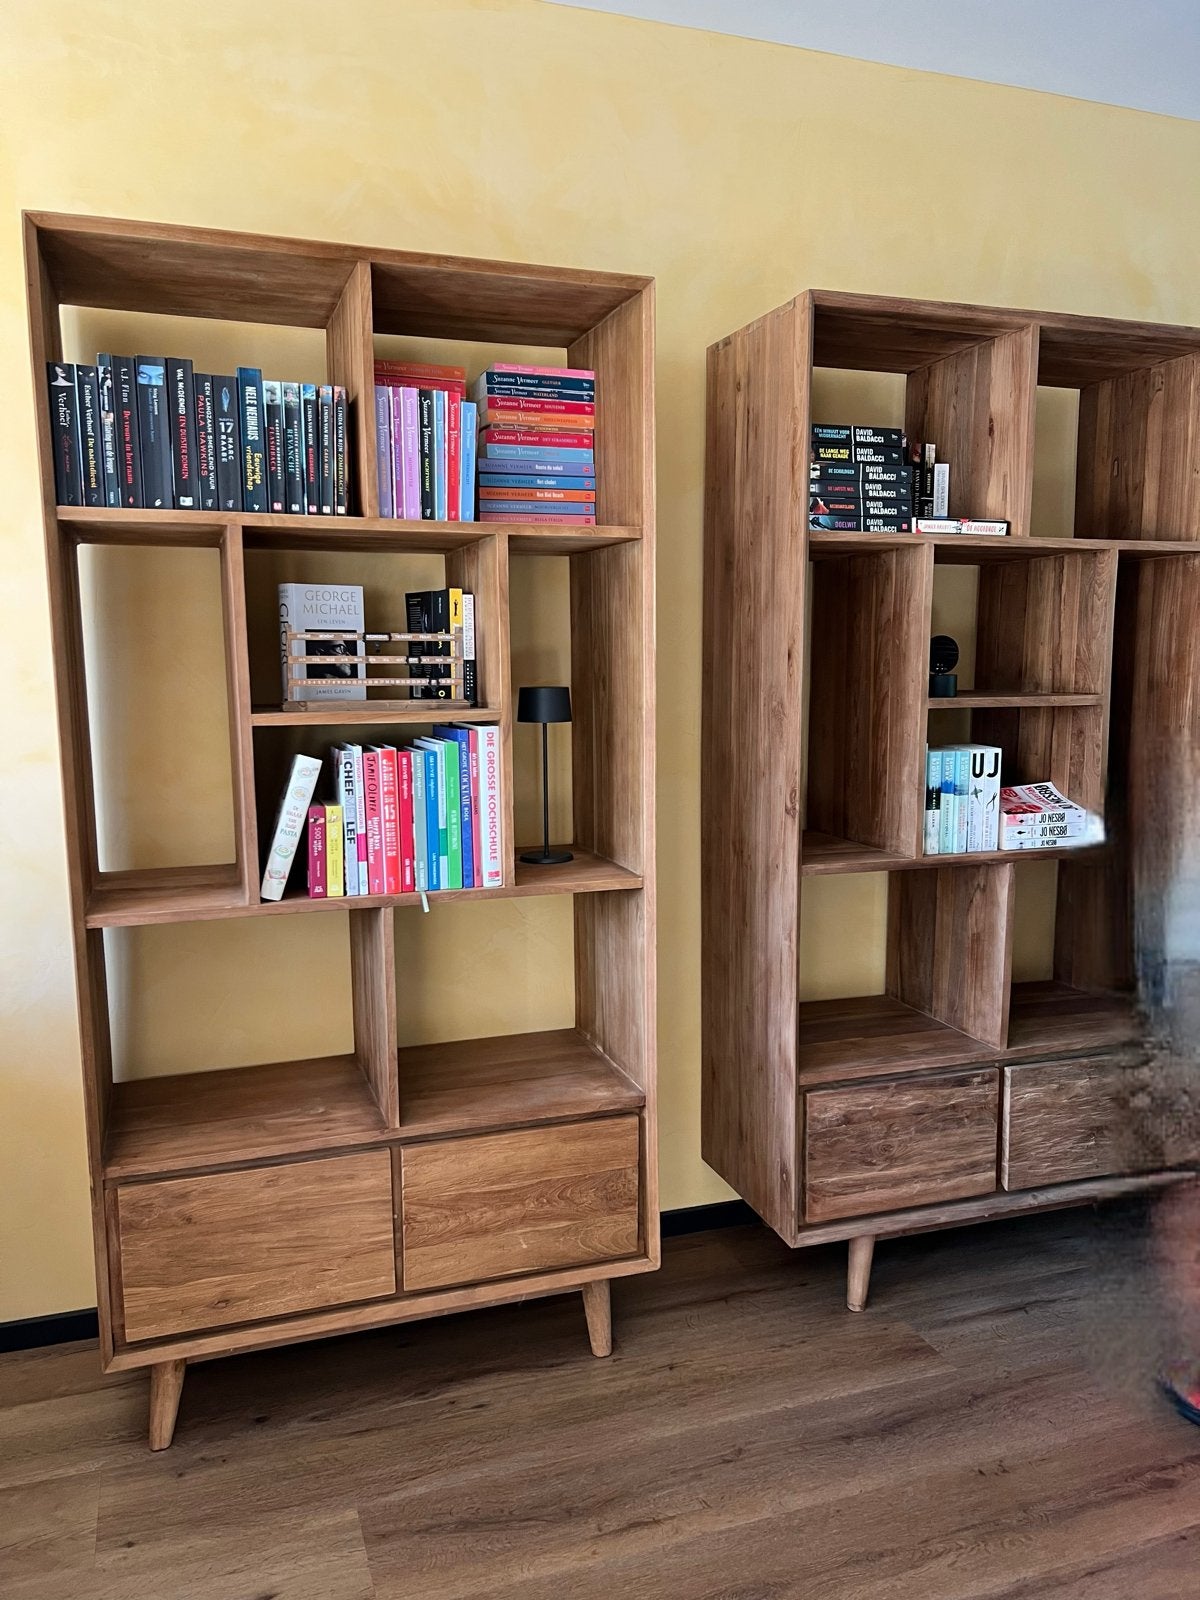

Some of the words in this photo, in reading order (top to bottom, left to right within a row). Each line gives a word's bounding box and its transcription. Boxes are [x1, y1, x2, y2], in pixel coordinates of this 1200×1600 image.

[492, 374, 515, 383] Suzanne
[516, 376, 538, 385] Vermeer
[84, 384, 93, 407] Esther
[178, 382, 186, 414] McDERMID
[245, 386, 257, 404] NELE
[495, 398, 518, 407] Suzanne
[519, 400, 541, 408] Vermeer
[58, 392, 69, 427] Verhoef
[123, 410, 131, 420] De
[198, 395, 206, 427] PAULA
[377, 395, 387, 424] Suzanne
[405, 396, 414, 425] Suzanne
[421, 397, 431, 425] Suzanne
[450, 400, 458, 428] Suzanne
[495, 412, 517, 420] Suzanne
[518, 413, 540, 422] Vermeer
[86, 409, 95, 436] Verhoef
[124, 421, 132, 441] vrouw
[246, 406, 259, 441] NEUHAUS
[856, 428, 873, 436] DAVID
[88, 438, 94, 446] De
[180, 429, 188, 453] DUISTER
[220, 434, 228, 463] RAABE
[379, 425, 388, 453] Vermeer
[406, 426, 415, 453] Vermeer
[423, 427, 431, 453] Vermeer
[450, 430, 458, 456] Vermeer
[493, 432, 516, 441] Suzanne
[517, 433, 539, 441] Vermeer
[856, 435, 885, 443] BALDACCI
[200, 432, 208, 477] HAWKINS
[287, 428, 295, 474] REVANCHE
[494, 447, 516, 455] Suzanne
[517, 448, 539, 456] Vermeer
[88, 447, 97, 488] nachtdienst
[181, 455, 189, 479] DOMEIN
[246, 446, 254, 491] vriendschap
[254, 453, 263, 484] Eeuwige
[868, 472, 897, 480] BALDACCI
[866, 500, 883, 508] DAVID
[835, 521, 856, 529] DOELWIT
[866, 518, 883, 526] DAVID
[304, 589, 357, 602] GEORGE
[303, 603, 360, 615] MICHAEL
[487, 732, 496, 747] DIE
[344, 761, 354, 795] CHEF
[383, 759, 395, 792] JAMIE
[488, 751, 496, 790] GROSSE
[386, 794, 395, 803] IN
[462, 769, 470, 805] COCKTAIL
[489, 794, 498, 861] KOCHSCHULE
[1039, 814, 1047, 824] JO
[1047, 812, 1066, 823] NESBØ
[280, 828, 298, 838] PASTA
[314, 826, 322, 840] 500
[346, 821, 356, 845] LEF
[386, 822, 397, 857] MINUTEN
[1040, 827, 1048, 836] JO
[1049, 825, 1068, 836] NESBØ
